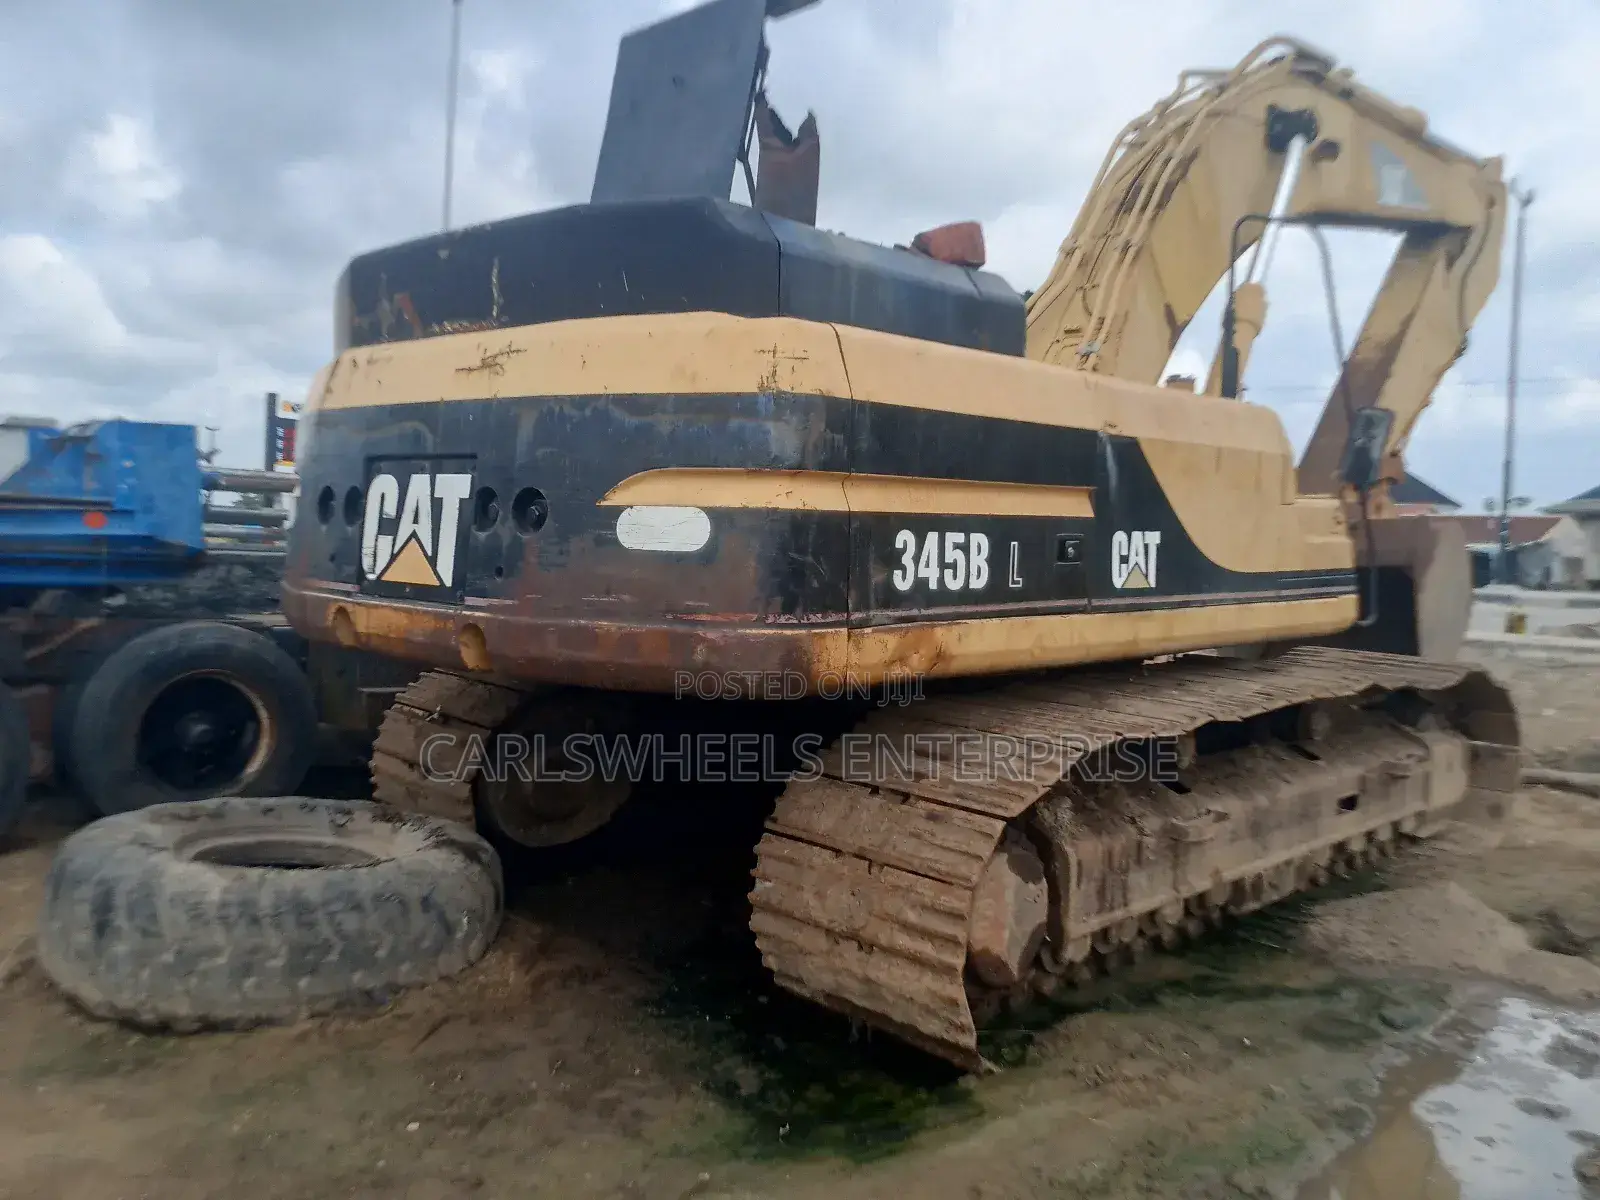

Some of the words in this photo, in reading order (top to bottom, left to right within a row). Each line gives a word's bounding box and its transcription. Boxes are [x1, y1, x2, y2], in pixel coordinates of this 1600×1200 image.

[361, 472, 472, 588] CAT
[892, 528, 989, 592] 345B
[1007, 541, 1023, 588] L
[1111, 529, 1161, 589] CAT
